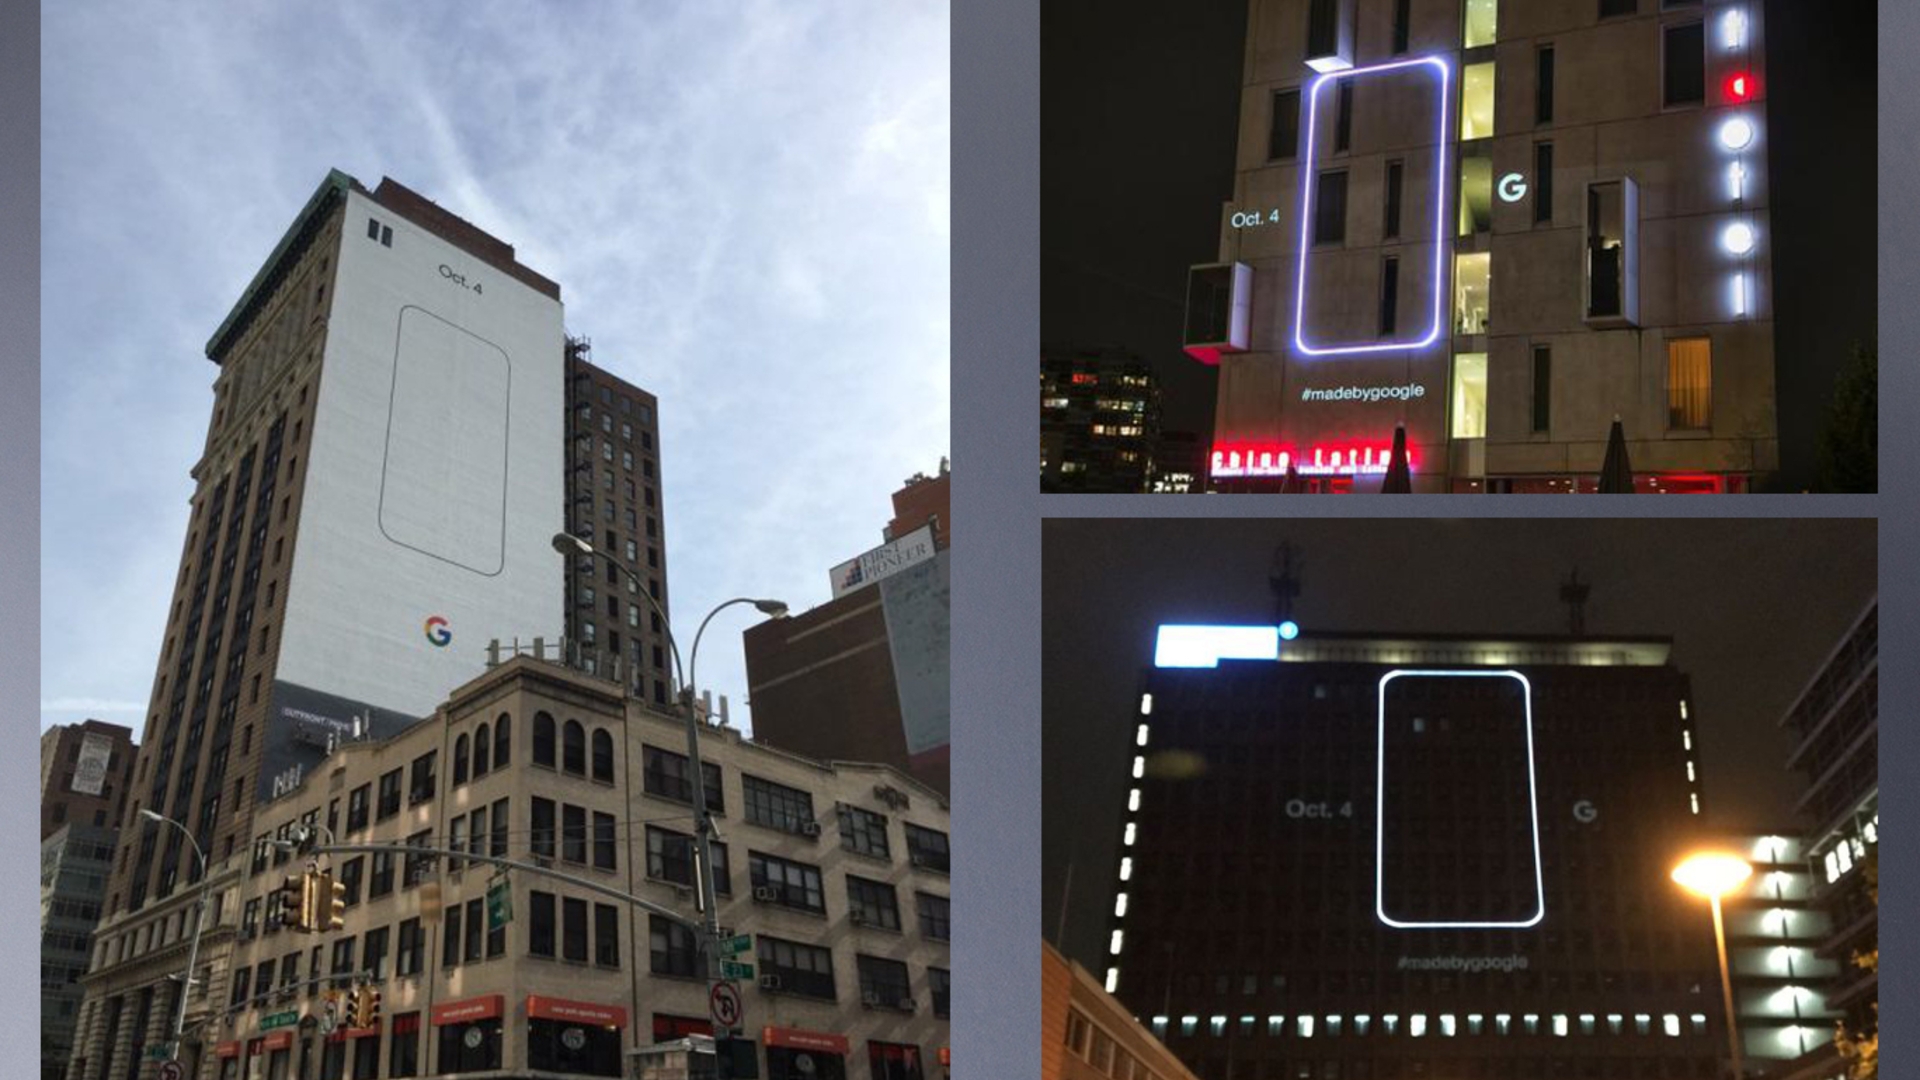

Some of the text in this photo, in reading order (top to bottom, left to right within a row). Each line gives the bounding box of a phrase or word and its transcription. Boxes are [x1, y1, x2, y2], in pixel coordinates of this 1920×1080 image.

[1498, 173, 1527, 201] G
[1231, 209, 1280, 228] Oct. 4
[438, 264, 483, 294] Oct. 4
[1302, 383, 1425, 401] #madebygoogle
[864, 542, 926, 580] PIONEER
[425, 616, 452, 647] G
[1285, 800, 1353, 819] Oct. 4
[1573, 801, 1597, 823] G
[1398, 954, 1529, 972] #madebygoogle
